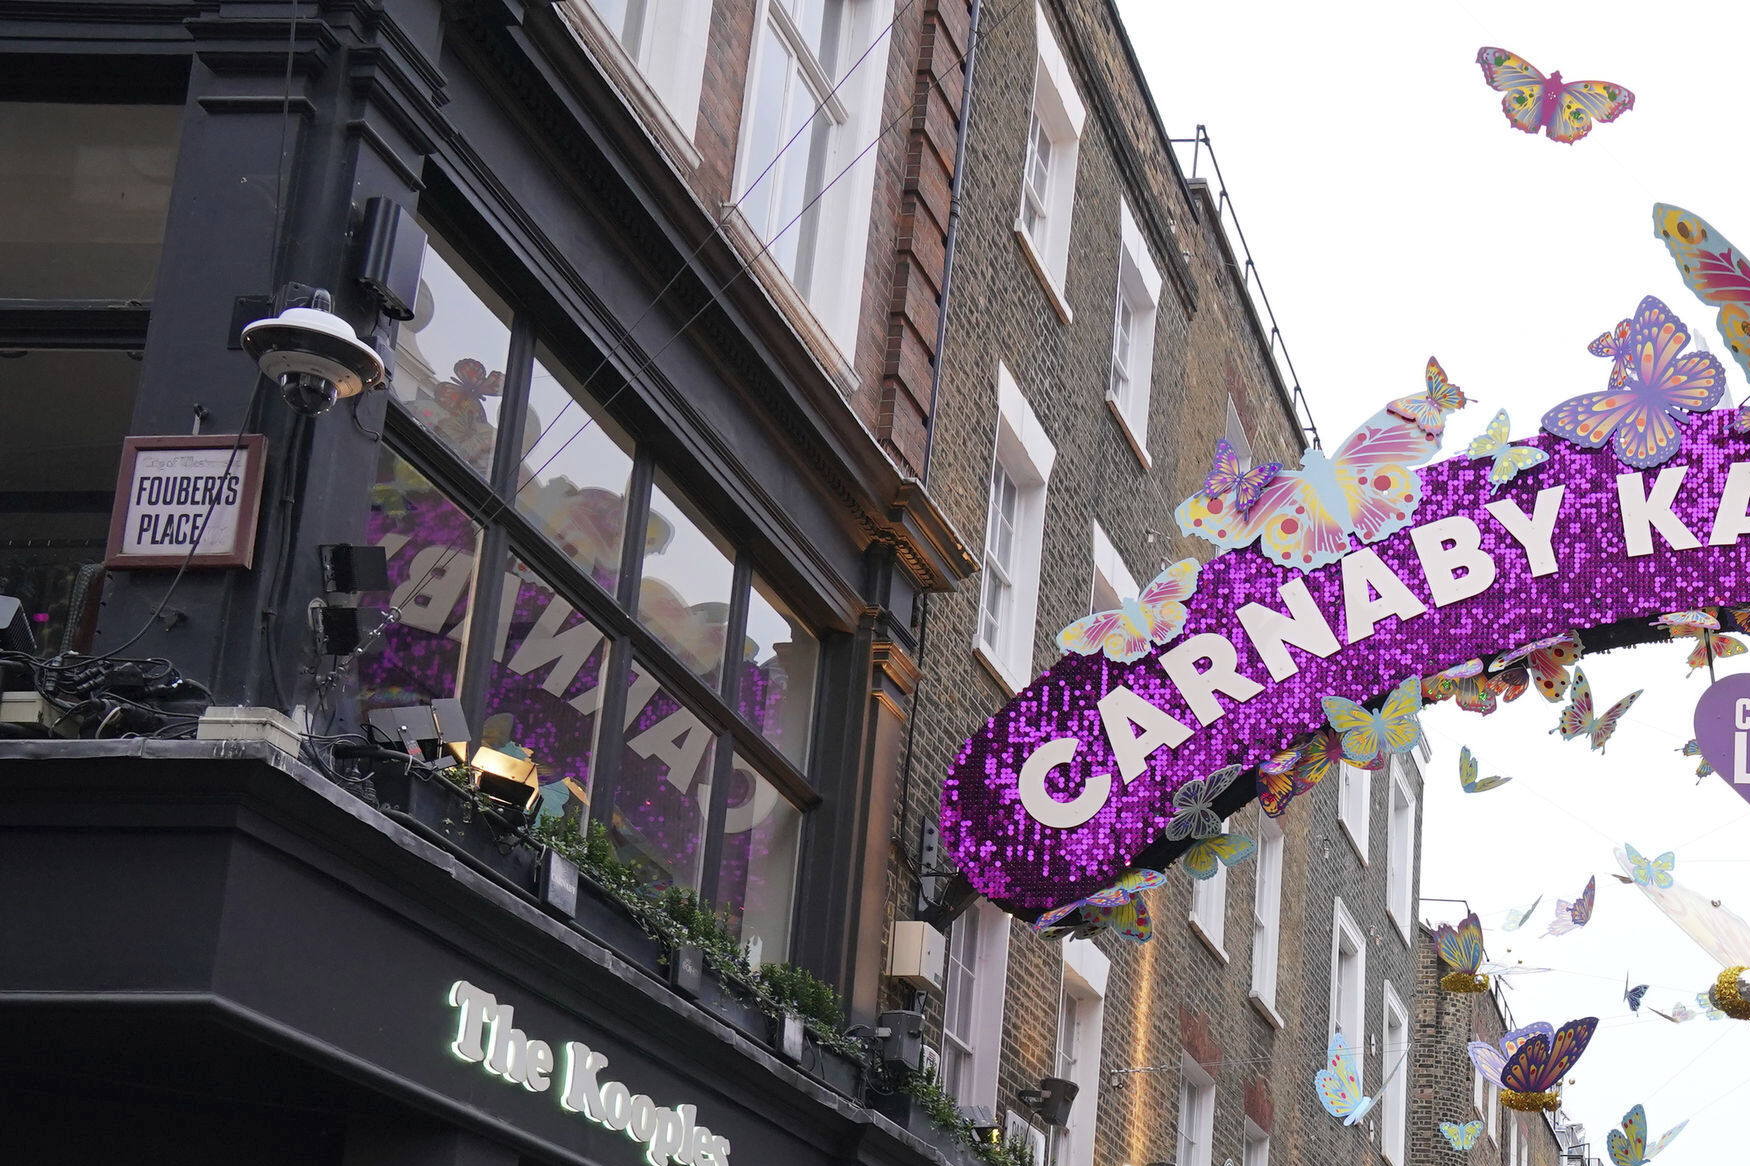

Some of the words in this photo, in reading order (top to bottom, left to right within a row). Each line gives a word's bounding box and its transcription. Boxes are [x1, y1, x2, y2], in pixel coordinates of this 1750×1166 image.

[137, 513, 203, 545] PLACE
[1018, 485, 1566, 829] CARNABY
[449, 980, 553, 1092] The
